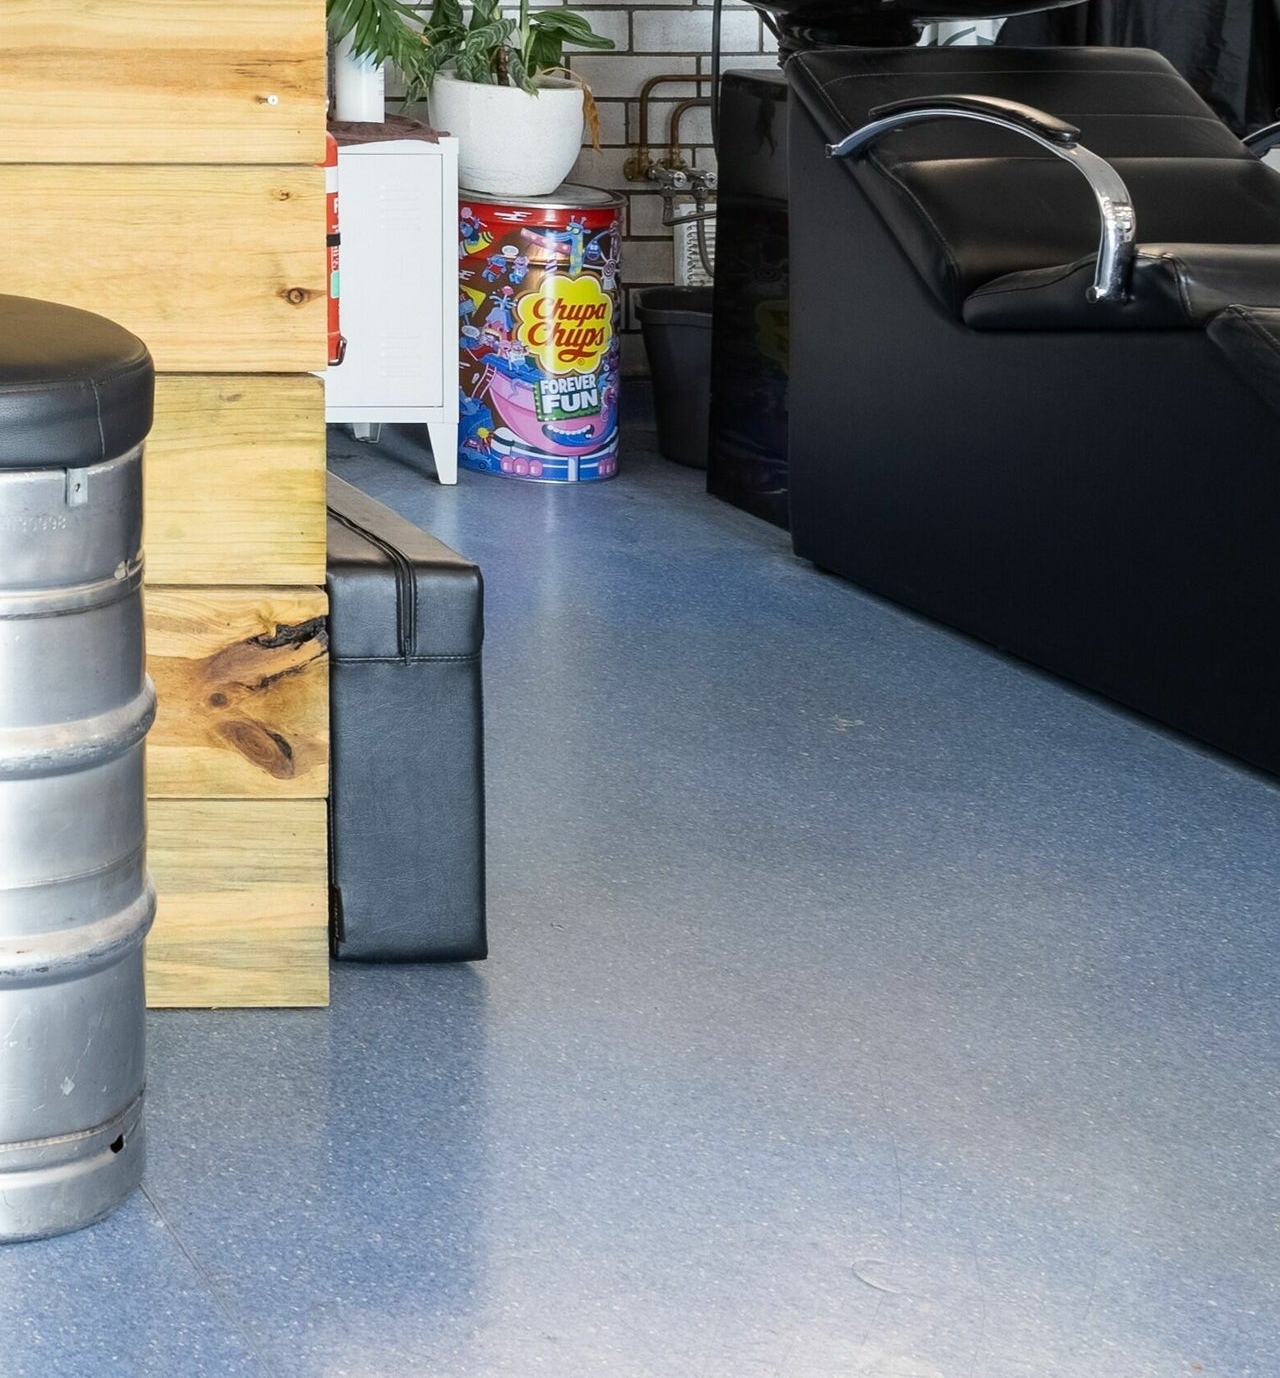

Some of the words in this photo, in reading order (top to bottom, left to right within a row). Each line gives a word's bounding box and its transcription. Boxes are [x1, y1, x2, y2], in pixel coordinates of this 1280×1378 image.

[533, 297, 607, 328] Chupa
[528, 322, 605, 363] Chups
[540, 374, 596, 396] FOREVER
[543, 388, 599, 414] FUN
